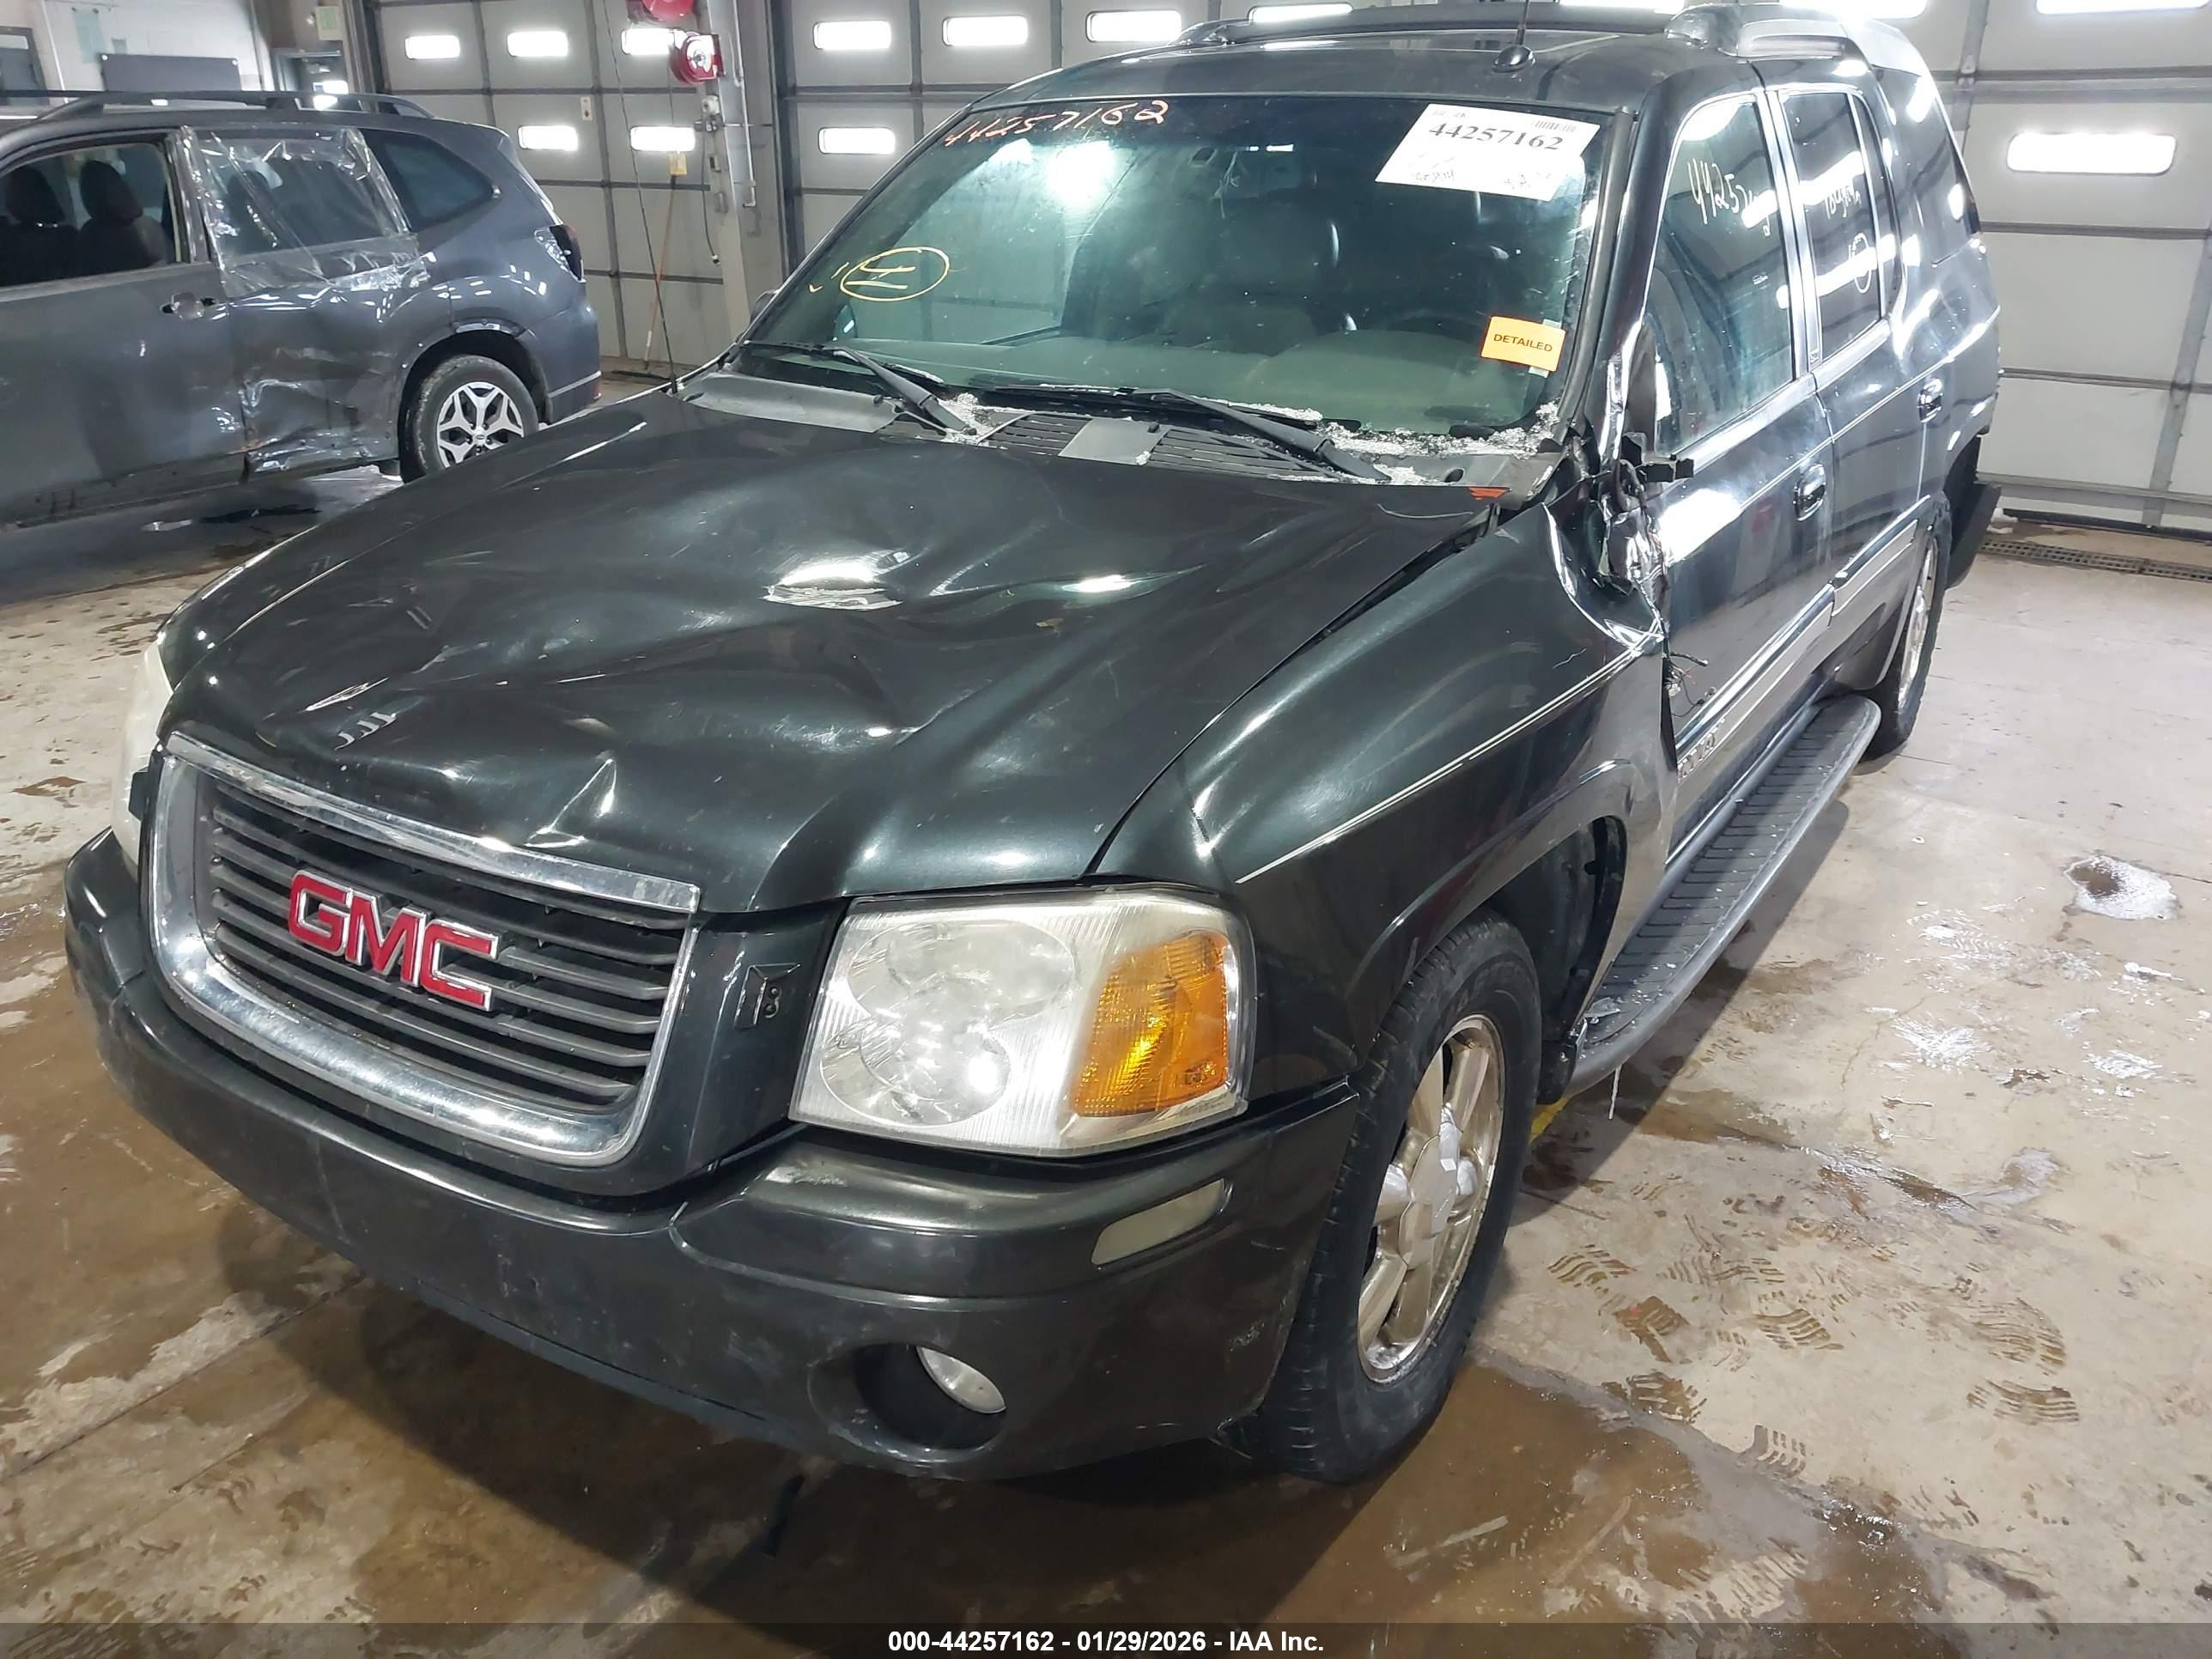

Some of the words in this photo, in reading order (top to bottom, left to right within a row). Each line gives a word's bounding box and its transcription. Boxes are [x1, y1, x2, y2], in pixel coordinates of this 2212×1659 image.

[945, 100, 1169, 147] 44257162
[1428, 122, 1564, 151] 44257162
[1493, 333, 1553, 352] DETAILED
[288, 868, 501, 1012] GMC
